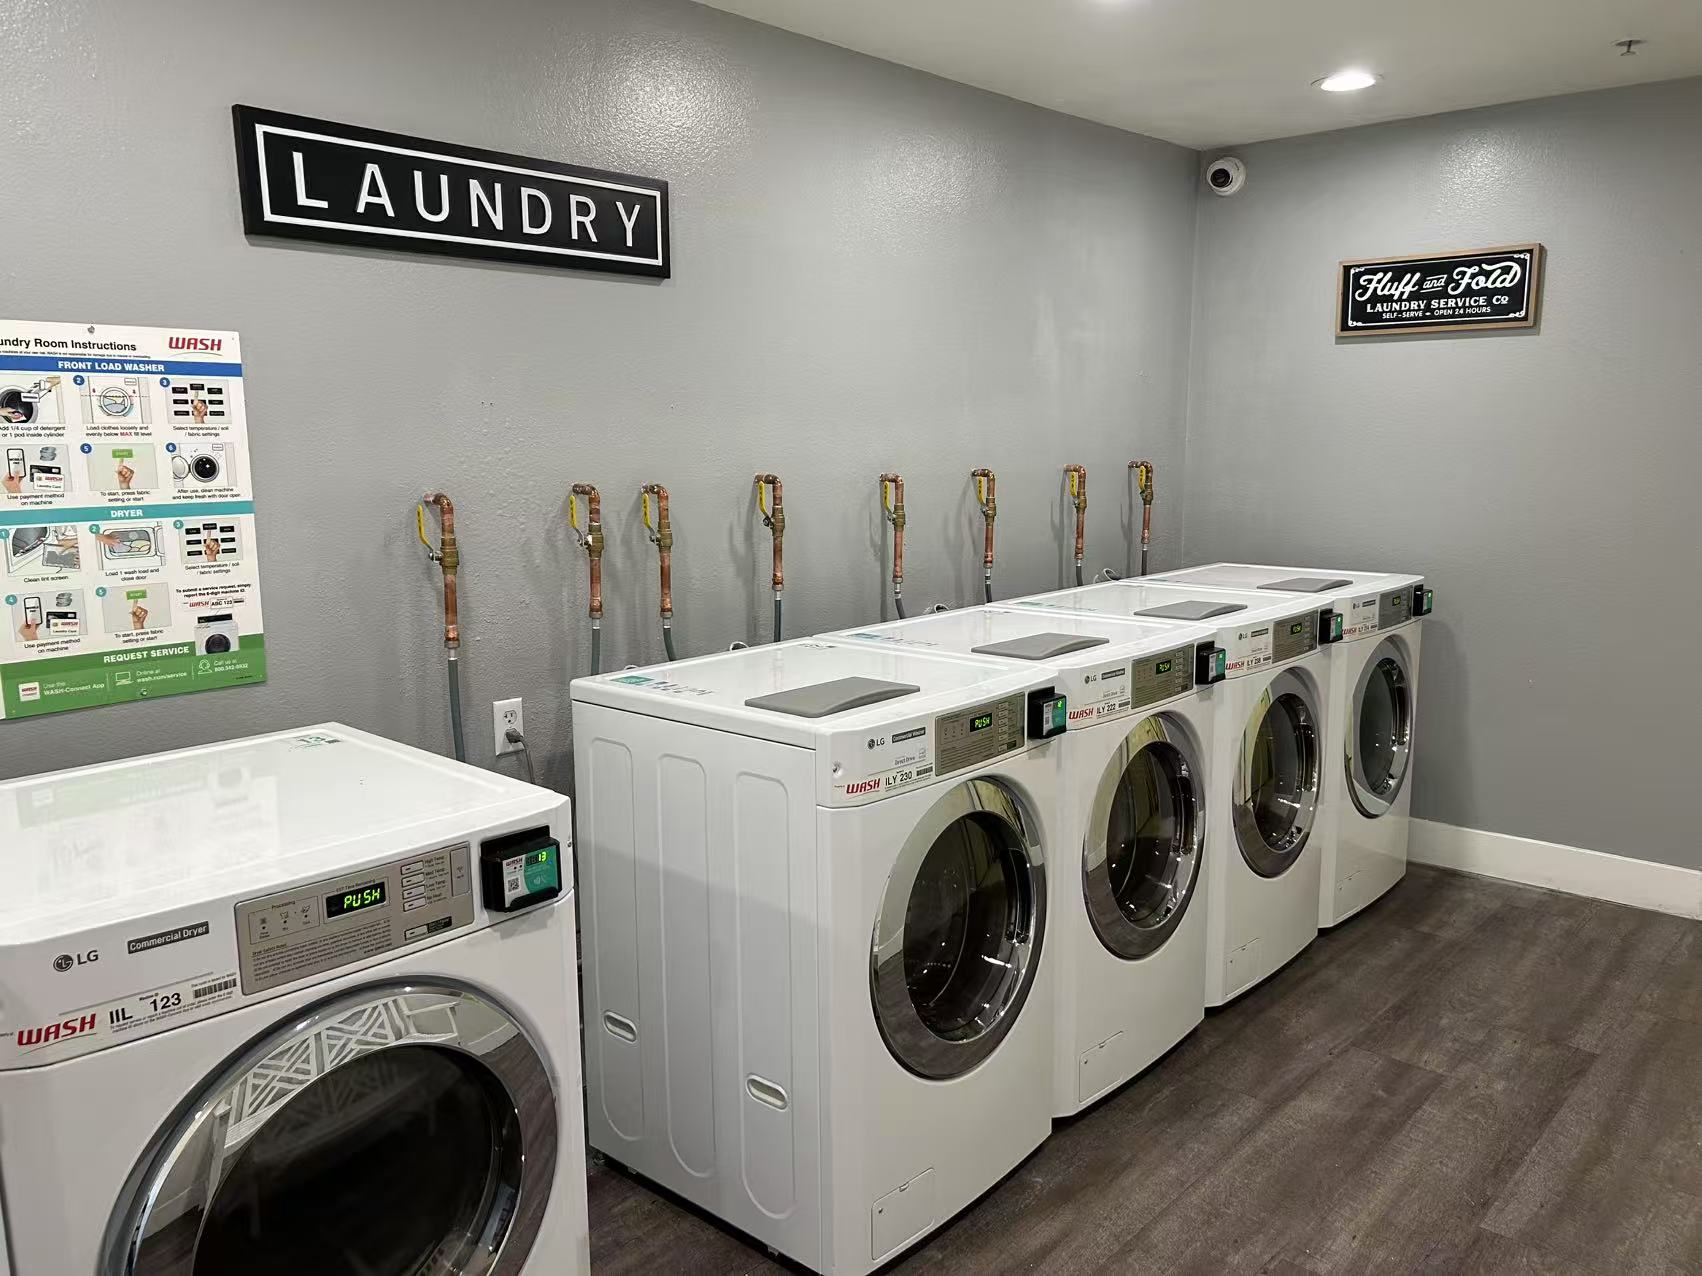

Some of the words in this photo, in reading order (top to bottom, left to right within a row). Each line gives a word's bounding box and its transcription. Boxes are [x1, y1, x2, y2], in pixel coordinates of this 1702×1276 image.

[292, 151, 640, 247] LAUNDRY
[1355, 271, 1420, 301] Fluff
[1422, 276, 1446, 290] and
[1448, 261, 1521, 296] Fold
[1366, 300, 1426, 312] LAUNDRY
[1431, 297, 1487, 309] SERVICE
[34, 338, 68, 348] Room
[71, 340, 137, 351] Instructions
[168, 337, 222, 351] WASH
[58, 361, 92, 369] FRONT
[95, 362, 121, 370] LOAD
[124, 363, 165, 371] WASHER
[110, 509, 143, 518] DRYER
[103, 651, 148, 663] REQUEST
[150, 646, 190, 657] SERVICE
[1226, 661, 1244, 670] WASH
[43, 685, 91, 695] WASH-Connect
[1069, 708, 1094, 720] WASH
[1096, 706, 1105, 714] ILY
[1106, 703, 1116, 712] 222
[975, 717, 990, 727] PUSH
[876, 738, 885, 746] LG
[846, 778, 880, 794] WASH
[885, 775, 897, 786] ILY
[900, 771, 912, 781] 230
[506, 858, 522, 867] WASH
[538, 852, 547, 861] 13
[344, 888, 380, 909] PUSH
[129, 933, 181, 951] Commercial
[183, 924, 207, 938] Dryer
[77, 950, 99, 965] LG
[18, 1013, 96, 1046] WASH
[109, 1008, 133, 1024] IIL
[150, 992, 181, 1012] 123
